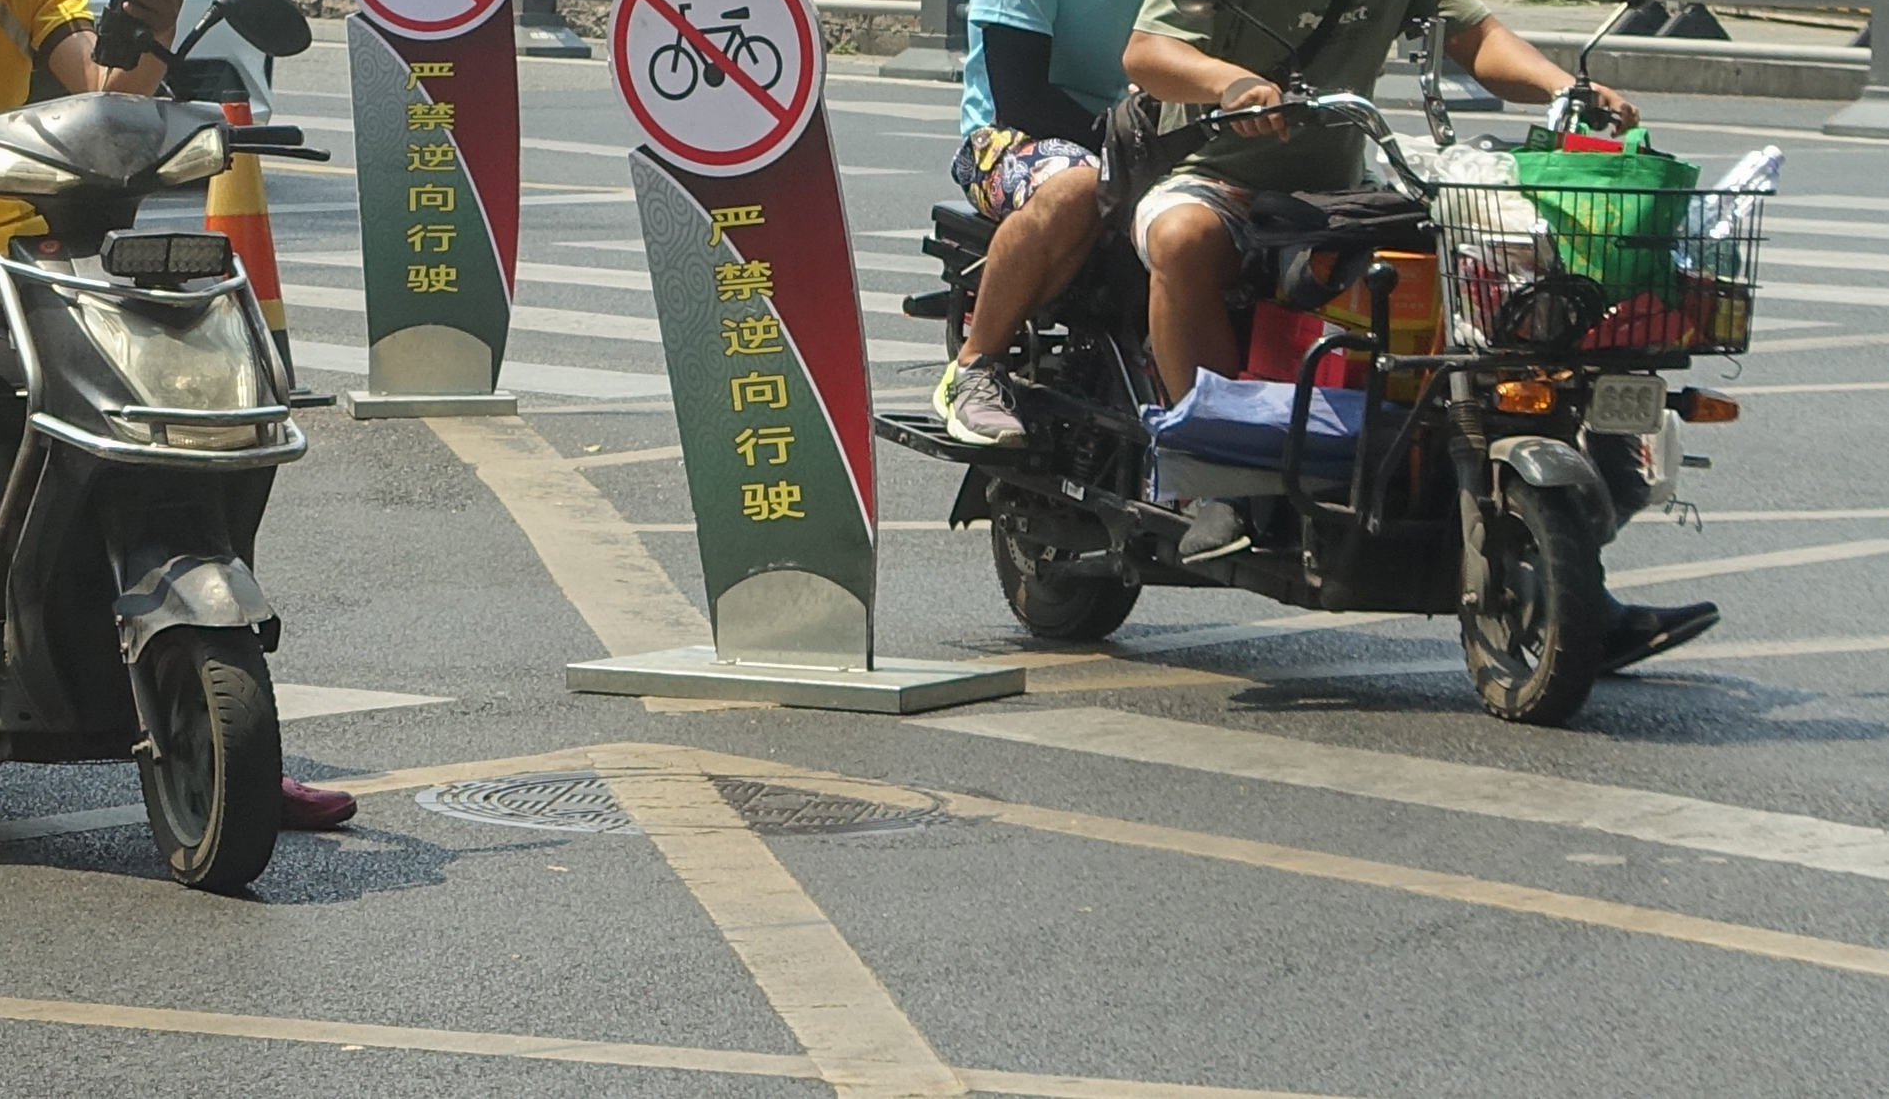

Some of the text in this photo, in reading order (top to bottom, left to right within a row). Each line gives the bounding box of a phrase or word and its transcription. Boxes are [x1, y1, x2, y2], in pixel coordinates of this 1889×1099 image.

[405, 62, 459, 293] 严禁逆向行驶
[708, 204, 806, 521] 严禁逆向行驶
